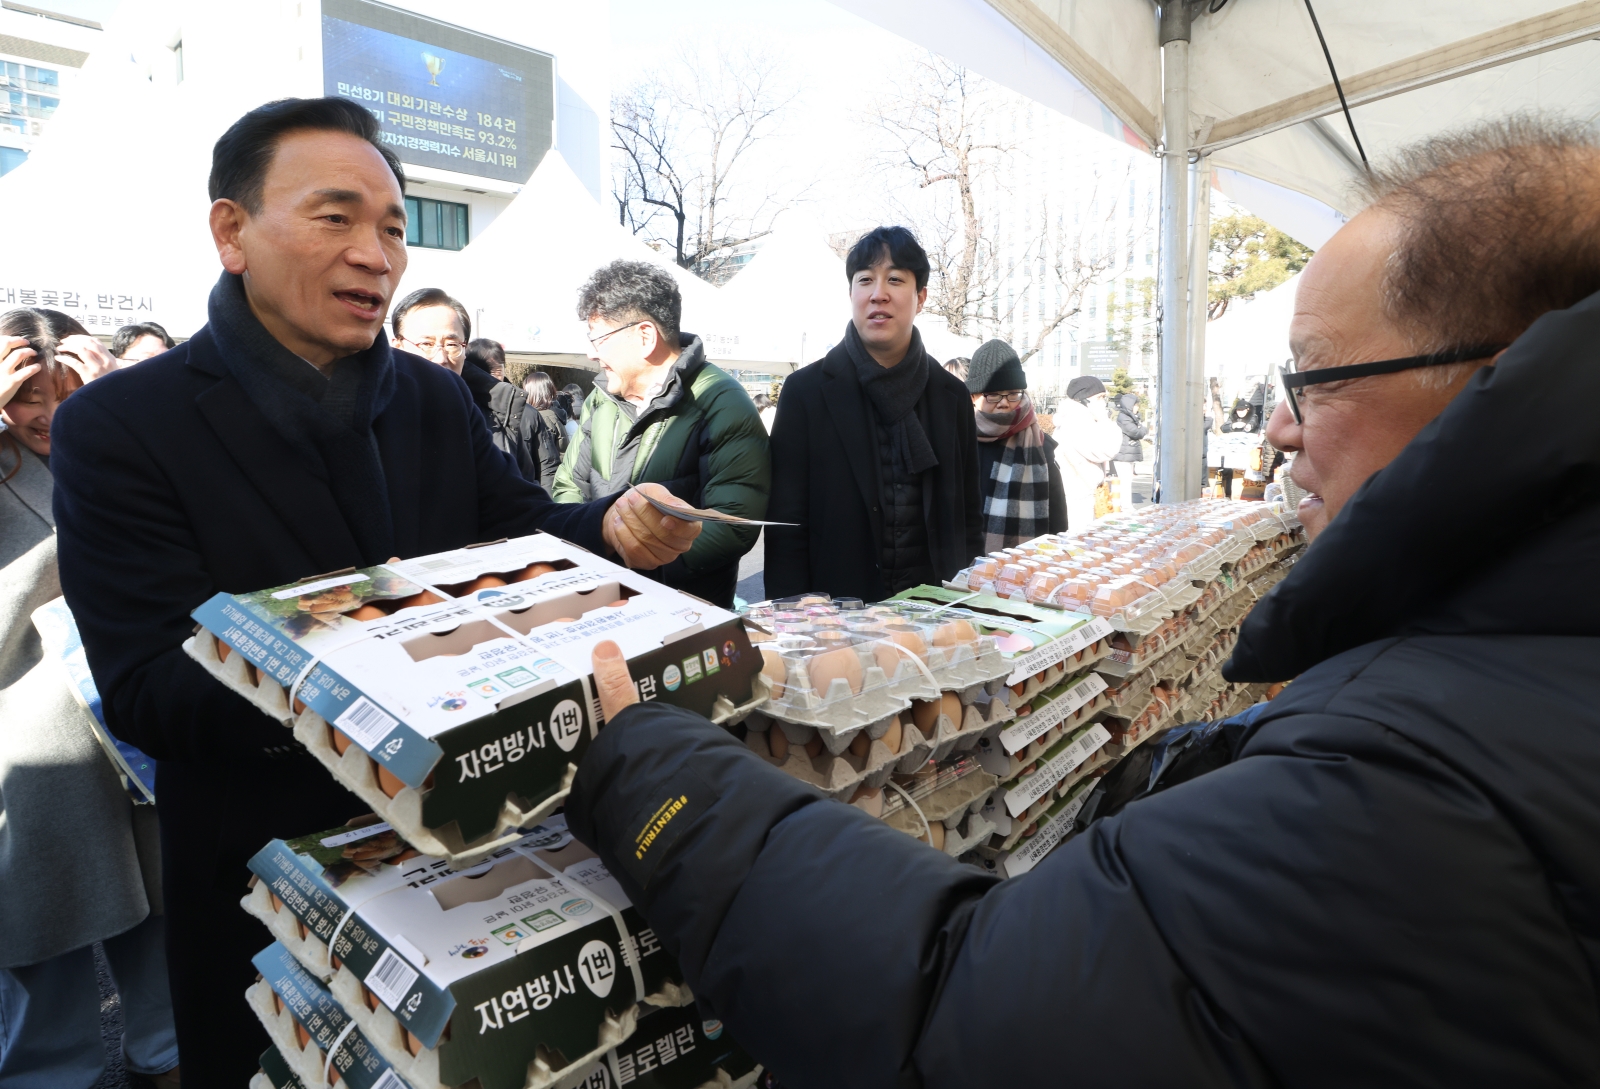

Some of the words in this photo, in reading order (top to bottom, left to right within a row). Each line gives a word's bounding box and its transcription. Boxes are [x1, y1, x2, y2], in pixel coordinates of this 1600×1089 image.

[337, 81, 384, 104] 민선8기
[387, 91, 468, 122] 대외기관수상
[477, 111, 516, 133] 184건
[388, 110, 476, 141] 구민정책만족도
[478, 130, 517, 151] 93.2%
[462, 147, 498, 166] 서울시
[500, 153, 517, 169] 1위
[98, 293, 153, 312] 반건시
[222, 604, 247, 625] 자가배양
[243, 620, 275, 645] 클로렐라를
[274, 640, 288, 655] 먹고
[285, 650, 302, 665] 자란
[317, 674, 334, 689] 닭이
[331, 684, 350, 701] 낳은
[223, 627, 267, 662] 사육환경번호
[264, 656, 281, 672] 1번
[276, 665, 298, 684] 방사
[455, 720, 547, 783] 자연방사
[552, 706, 580, 738] 1번
[273, 852, 294, 874] 자가배양
[290, 868, 316, 895] 클로렐라를
[314, 889, 327, 906] 먹고
[323, 900, 338, 917] 자란
[335, 911, 353, 931] 건한
[351, 925, 366, 943] 닭이
[362, 937, 378, 955] 낳은
[273, 876, 308, 914] 사육환경번호
[305, 908, 319, 925] 1번
[315, 917, 333, 938] 방사
[507, 887, 548, 904] 유정란
[510, 901, 535, 913] 닭이
[536, 887, 570, 903] 건강한
[276, 976, 311, 1018] 사육환경번호
[307, 1013, 321, 1032] 1번
[317, 1026, 336, 1049] 방사
[474, 964, 576, 1035] 자연방사
[580, 947, 614, 986] 1번
[293, 971, 321, 1000] 클로렐라를
[318, 995, 332, 1013] 먹고
[327, 1007, 342, 1026] 자란
[353, 1039, 367, 1058] 닭이
[363, 1053, 380, 1073] 낳은
[618, 1023, 696, 1086] 클로렐란
